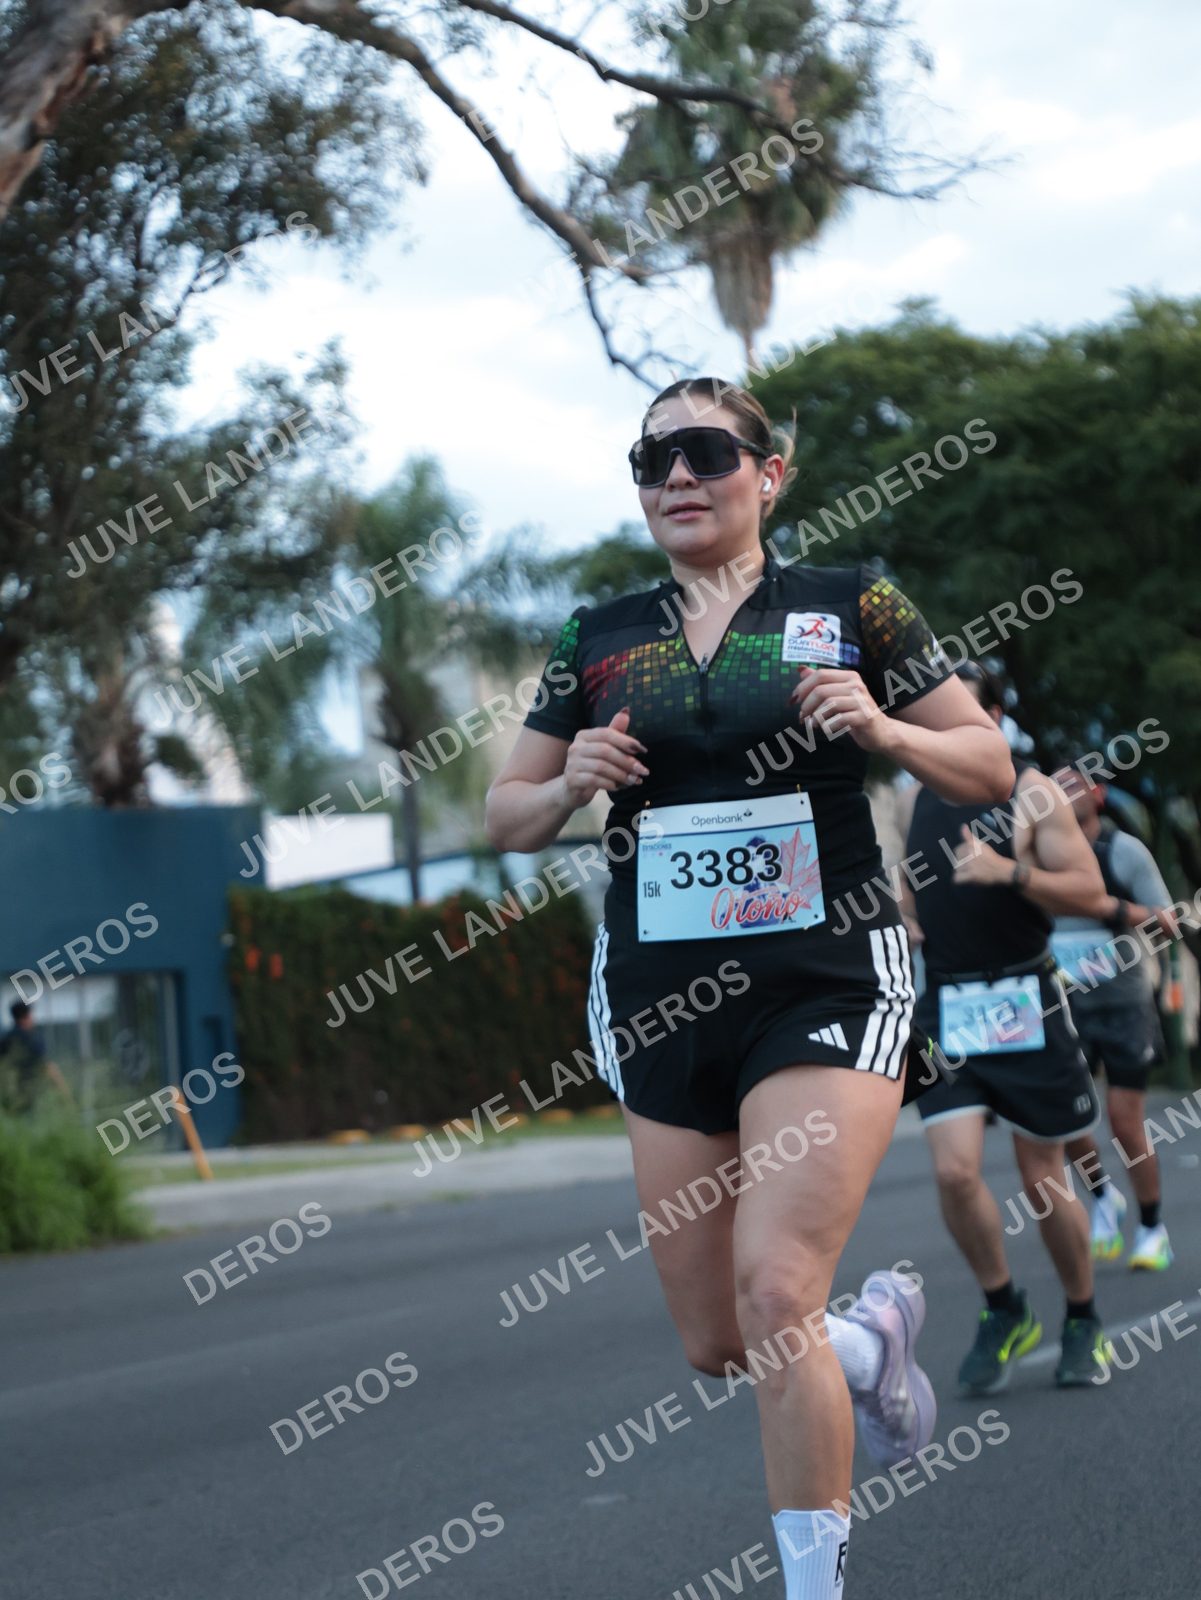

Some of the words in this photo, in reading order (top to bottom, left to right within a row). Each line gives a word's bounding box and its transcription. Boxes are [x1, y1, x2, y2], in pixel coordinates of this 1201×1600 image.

[691, 811, 743, 828] Openbank
[669, 842, 783, 890] 3383
[643, 880, 661, 898] 15k
